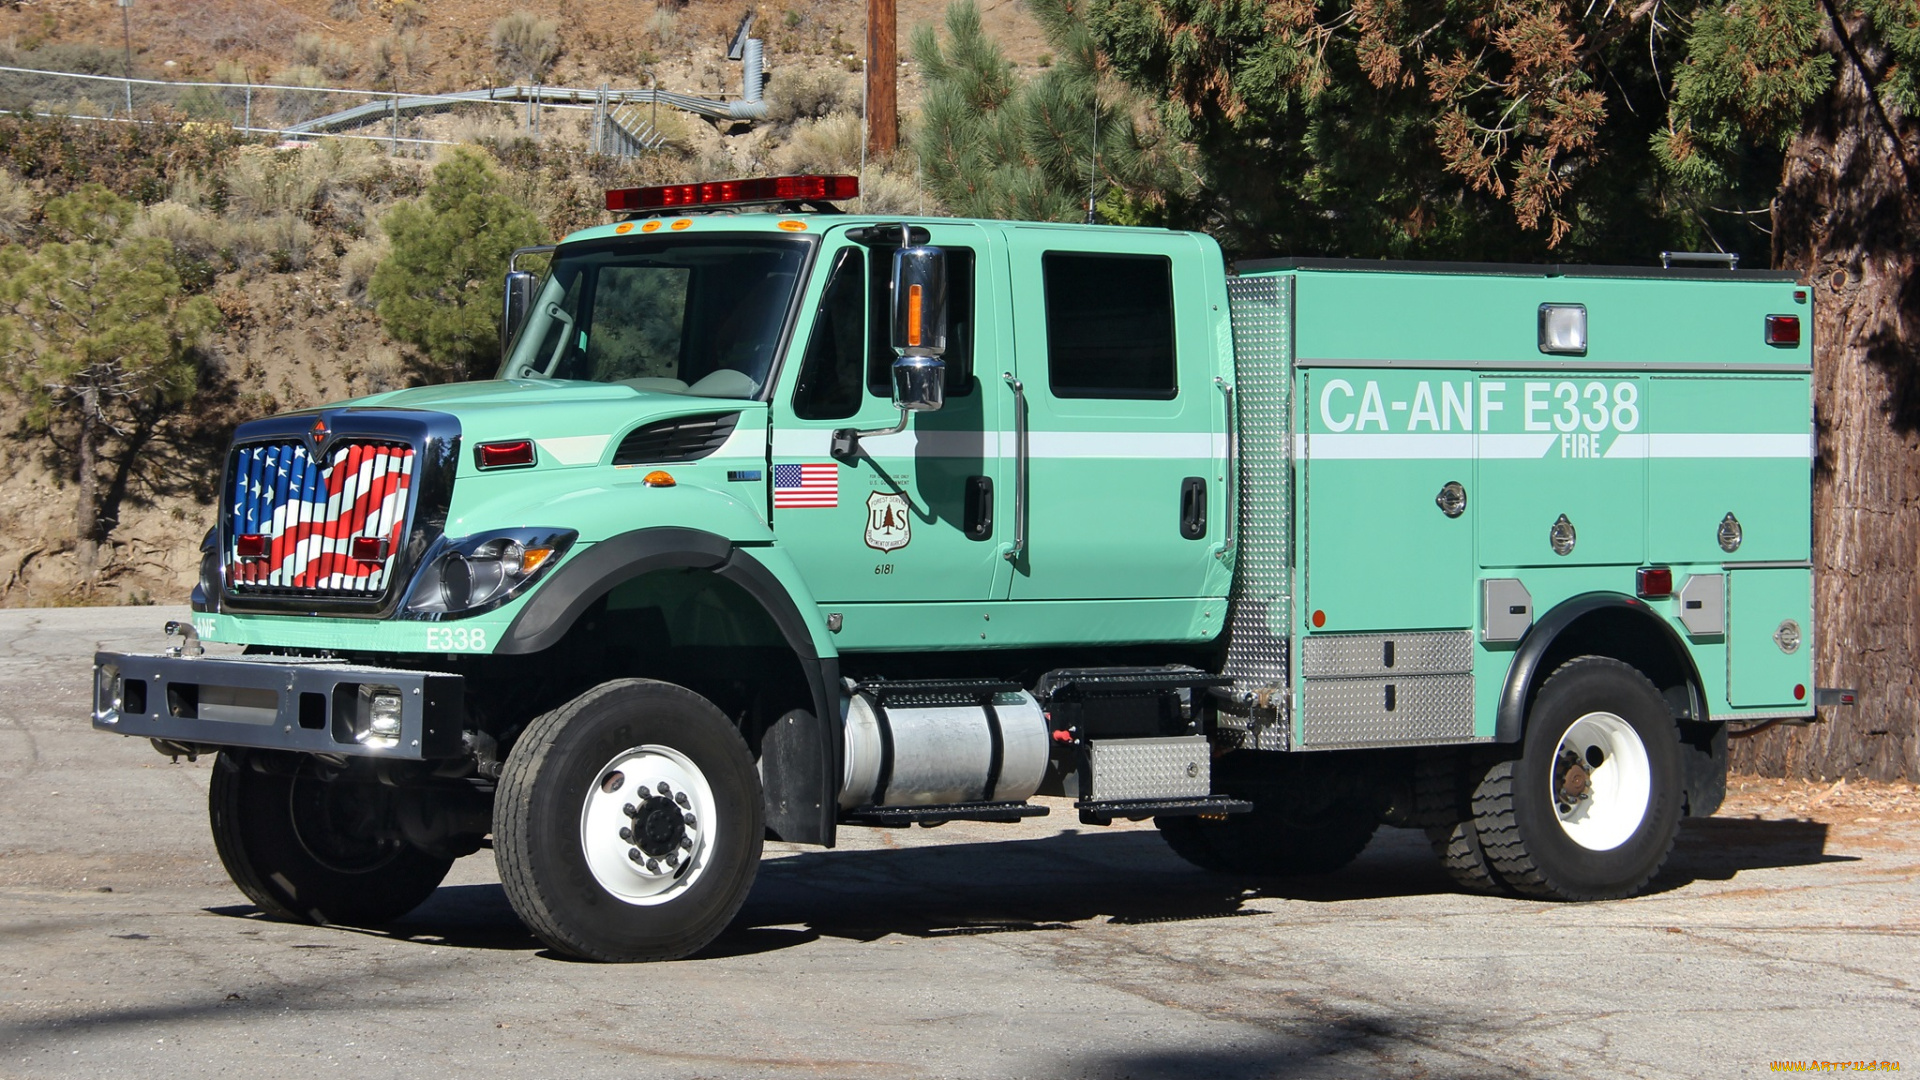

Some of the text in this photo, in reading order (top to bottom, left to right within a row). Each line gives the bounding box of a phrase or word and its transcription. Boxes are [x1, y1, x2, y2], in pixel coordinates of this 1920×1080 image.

[1319, 378, 1640, 433] CA-ANF E338
[1561, 433, 1601, 459] FIRE
[871, 496, 888, 507] FOREST
[874, 563, 894, 575] 6181
[426, 627, 487, 651] E338
